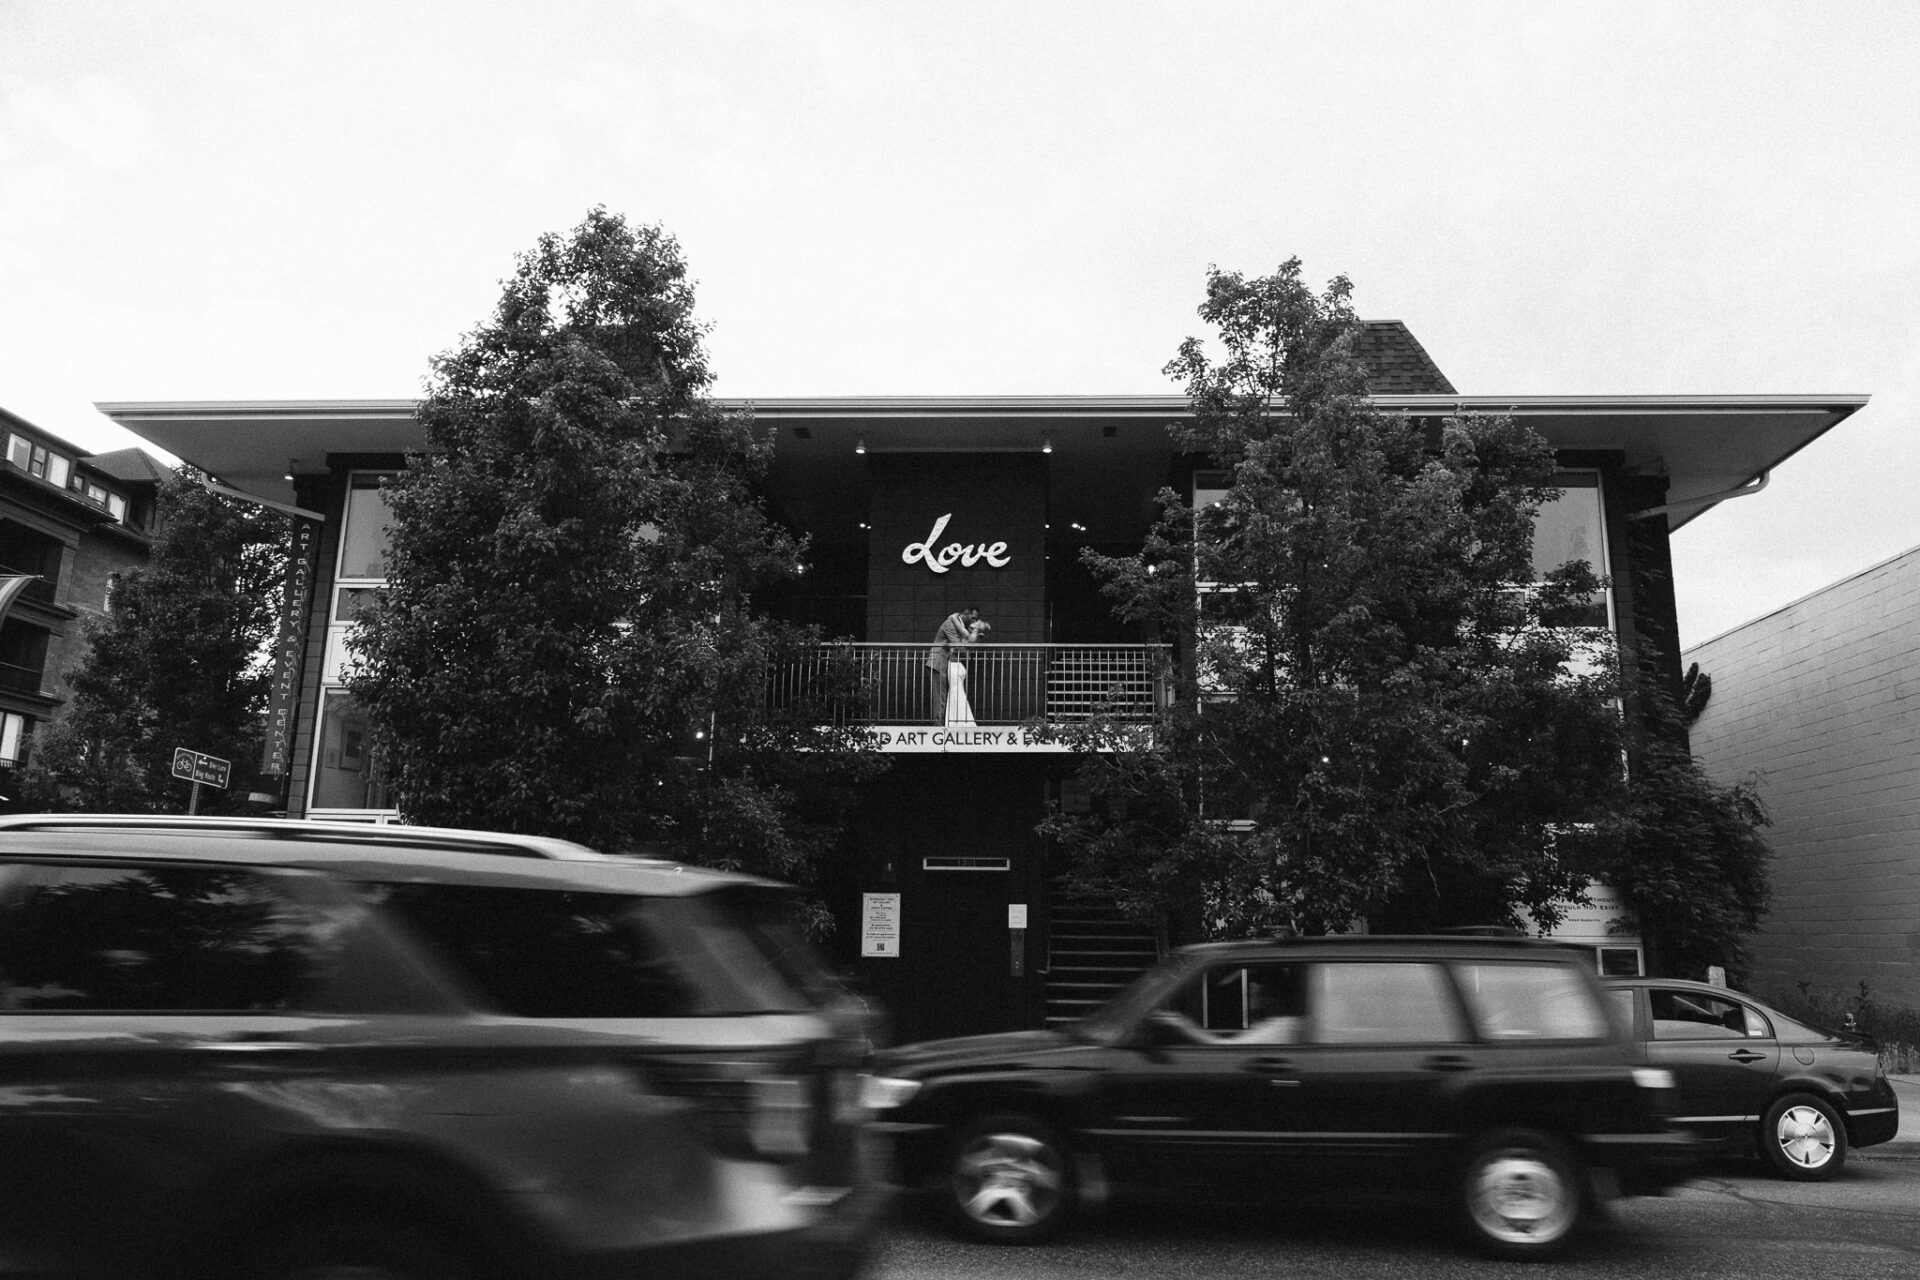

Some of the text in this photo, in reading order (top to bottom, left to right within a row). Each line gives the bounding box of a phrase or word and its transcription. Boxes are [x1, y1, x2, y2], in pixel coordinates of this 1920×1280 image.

[300, 523, 311, 550] ART
[902, 513, 1011, 573] Love
[290, 558, 306, 628] GALLERY
[280, 650, 294, 700] EVENT
[896, 732, 928, 745] ART
[932, 732, 1002, 745] GALLERY
[1007, 732, 1017, 745] &
